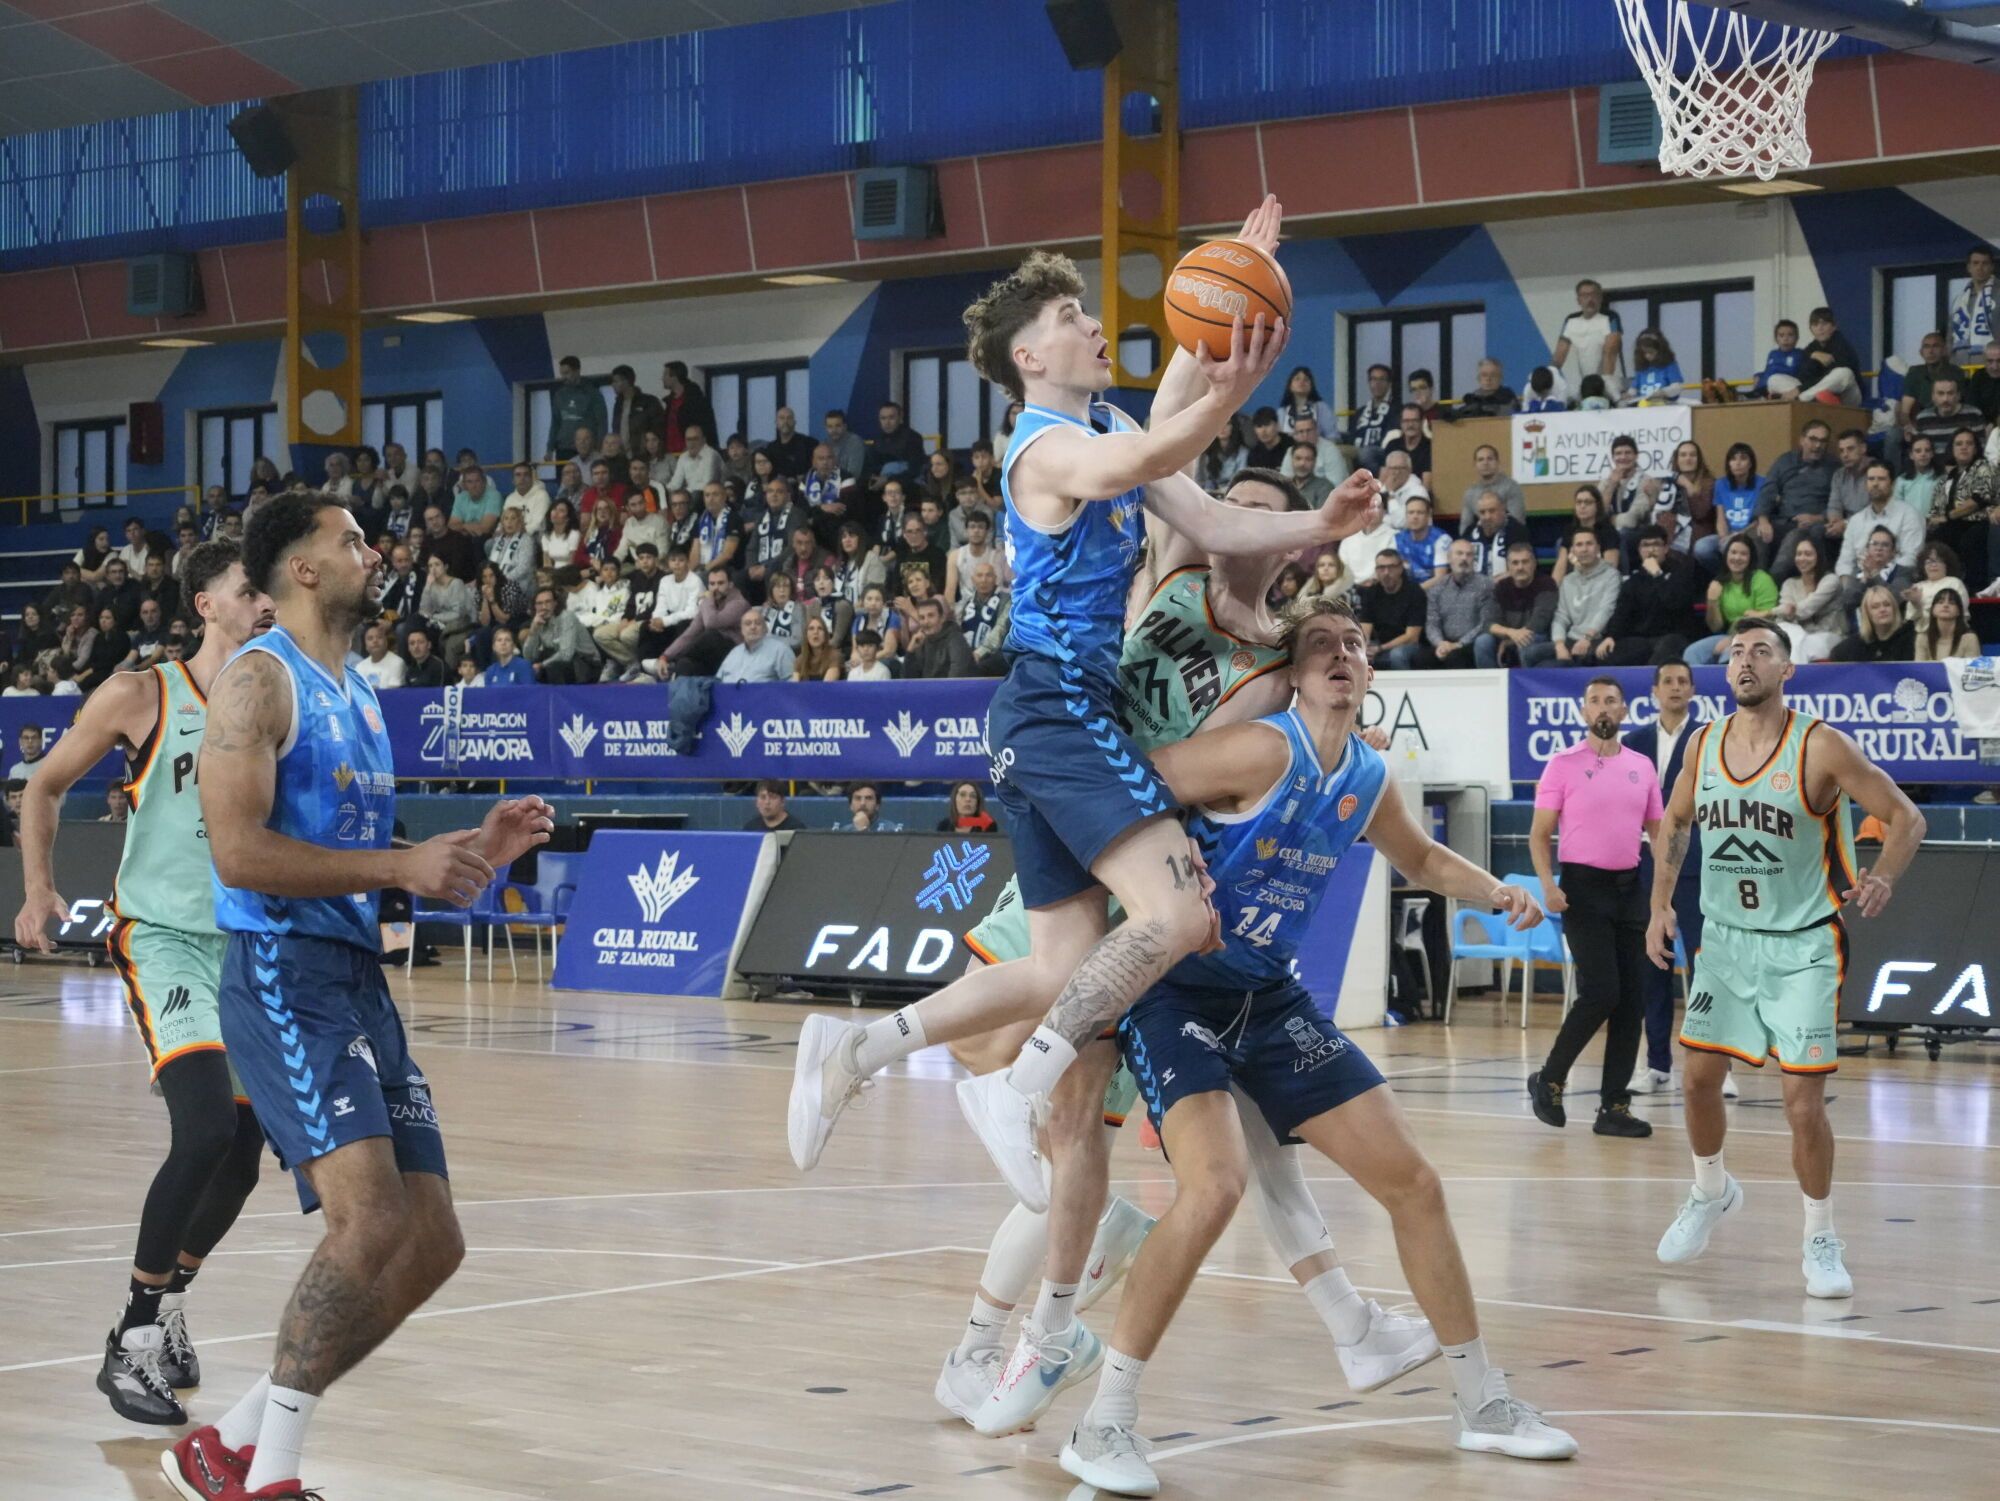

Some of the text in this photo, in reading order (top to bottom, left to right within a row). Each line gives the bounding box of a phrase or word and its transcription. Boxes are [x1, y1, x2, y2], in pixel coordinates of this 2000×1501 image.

[1173, 274, 1248, 318] Wilson
[1554, 449, 1674, 475] DE ZAOR
[1133, 610, 1222, 718] PALMER
[603, 720, 644, 741] CAJA
[762, 718, 871, 740] CAJA RURAL
[934, 717, 980, 740] CAJA
[604, 743, 621, 757] DE
[764, 741, 842, 756] DE ZAMORA
[934, 741, 956, 756] DE
[1853, 727, 1977, 761] RURAL
[1697, 798, 1794, 840] PALMER
[1295, 862, 1328, 876] ZAMORA
[1708, 863, 1785, 876] conectabalear
[1255, 888, 1305, 912] ZAMORA
[1738, 879, 1760, 910] 8
[592, 927, 699, 951] CAJA RURAL
[1230, 906, 1283, 948] 14
[597, 950, 676, 967] DE ZAMORA
[804, 924, 954, 974] FAD
[1866, 961, 1991, 1017] FA
[160, 1016, 196, 1033] ESPORTS
[1289, 1036, 1350, 1073] ZAMORA
